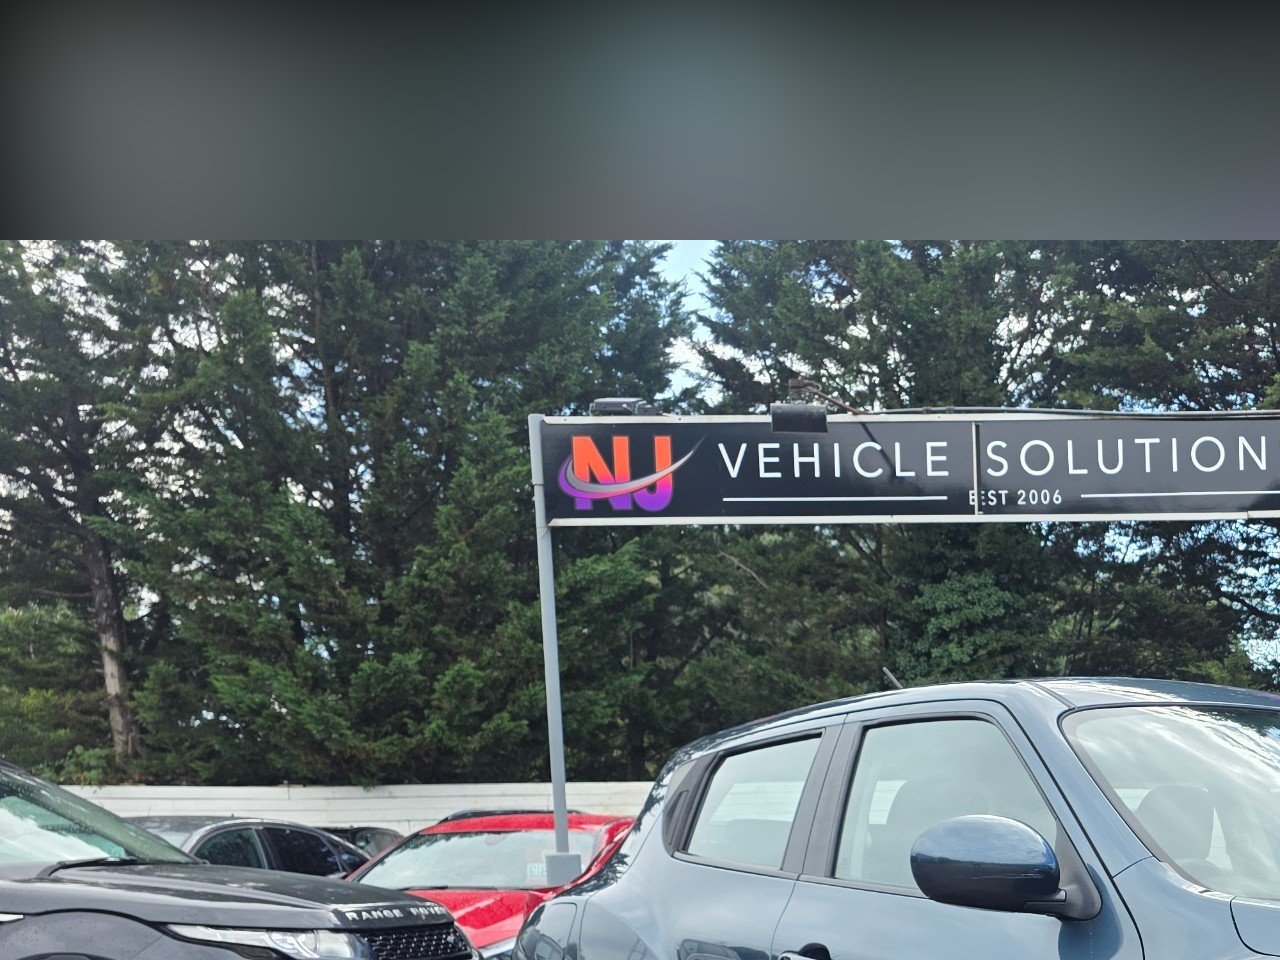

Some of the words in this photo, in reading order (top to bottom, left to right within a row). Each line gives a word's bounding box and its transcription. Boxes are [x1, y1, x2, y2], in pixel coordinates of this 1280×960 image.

[571, 435, 674, 511] NJ
[717, 441, 949, 479] VEHICLE
[968, 489, 1008, 506] EST
[1017, 488, 1063, 505] 2006
[345, 908, 404, 921] RANGE
